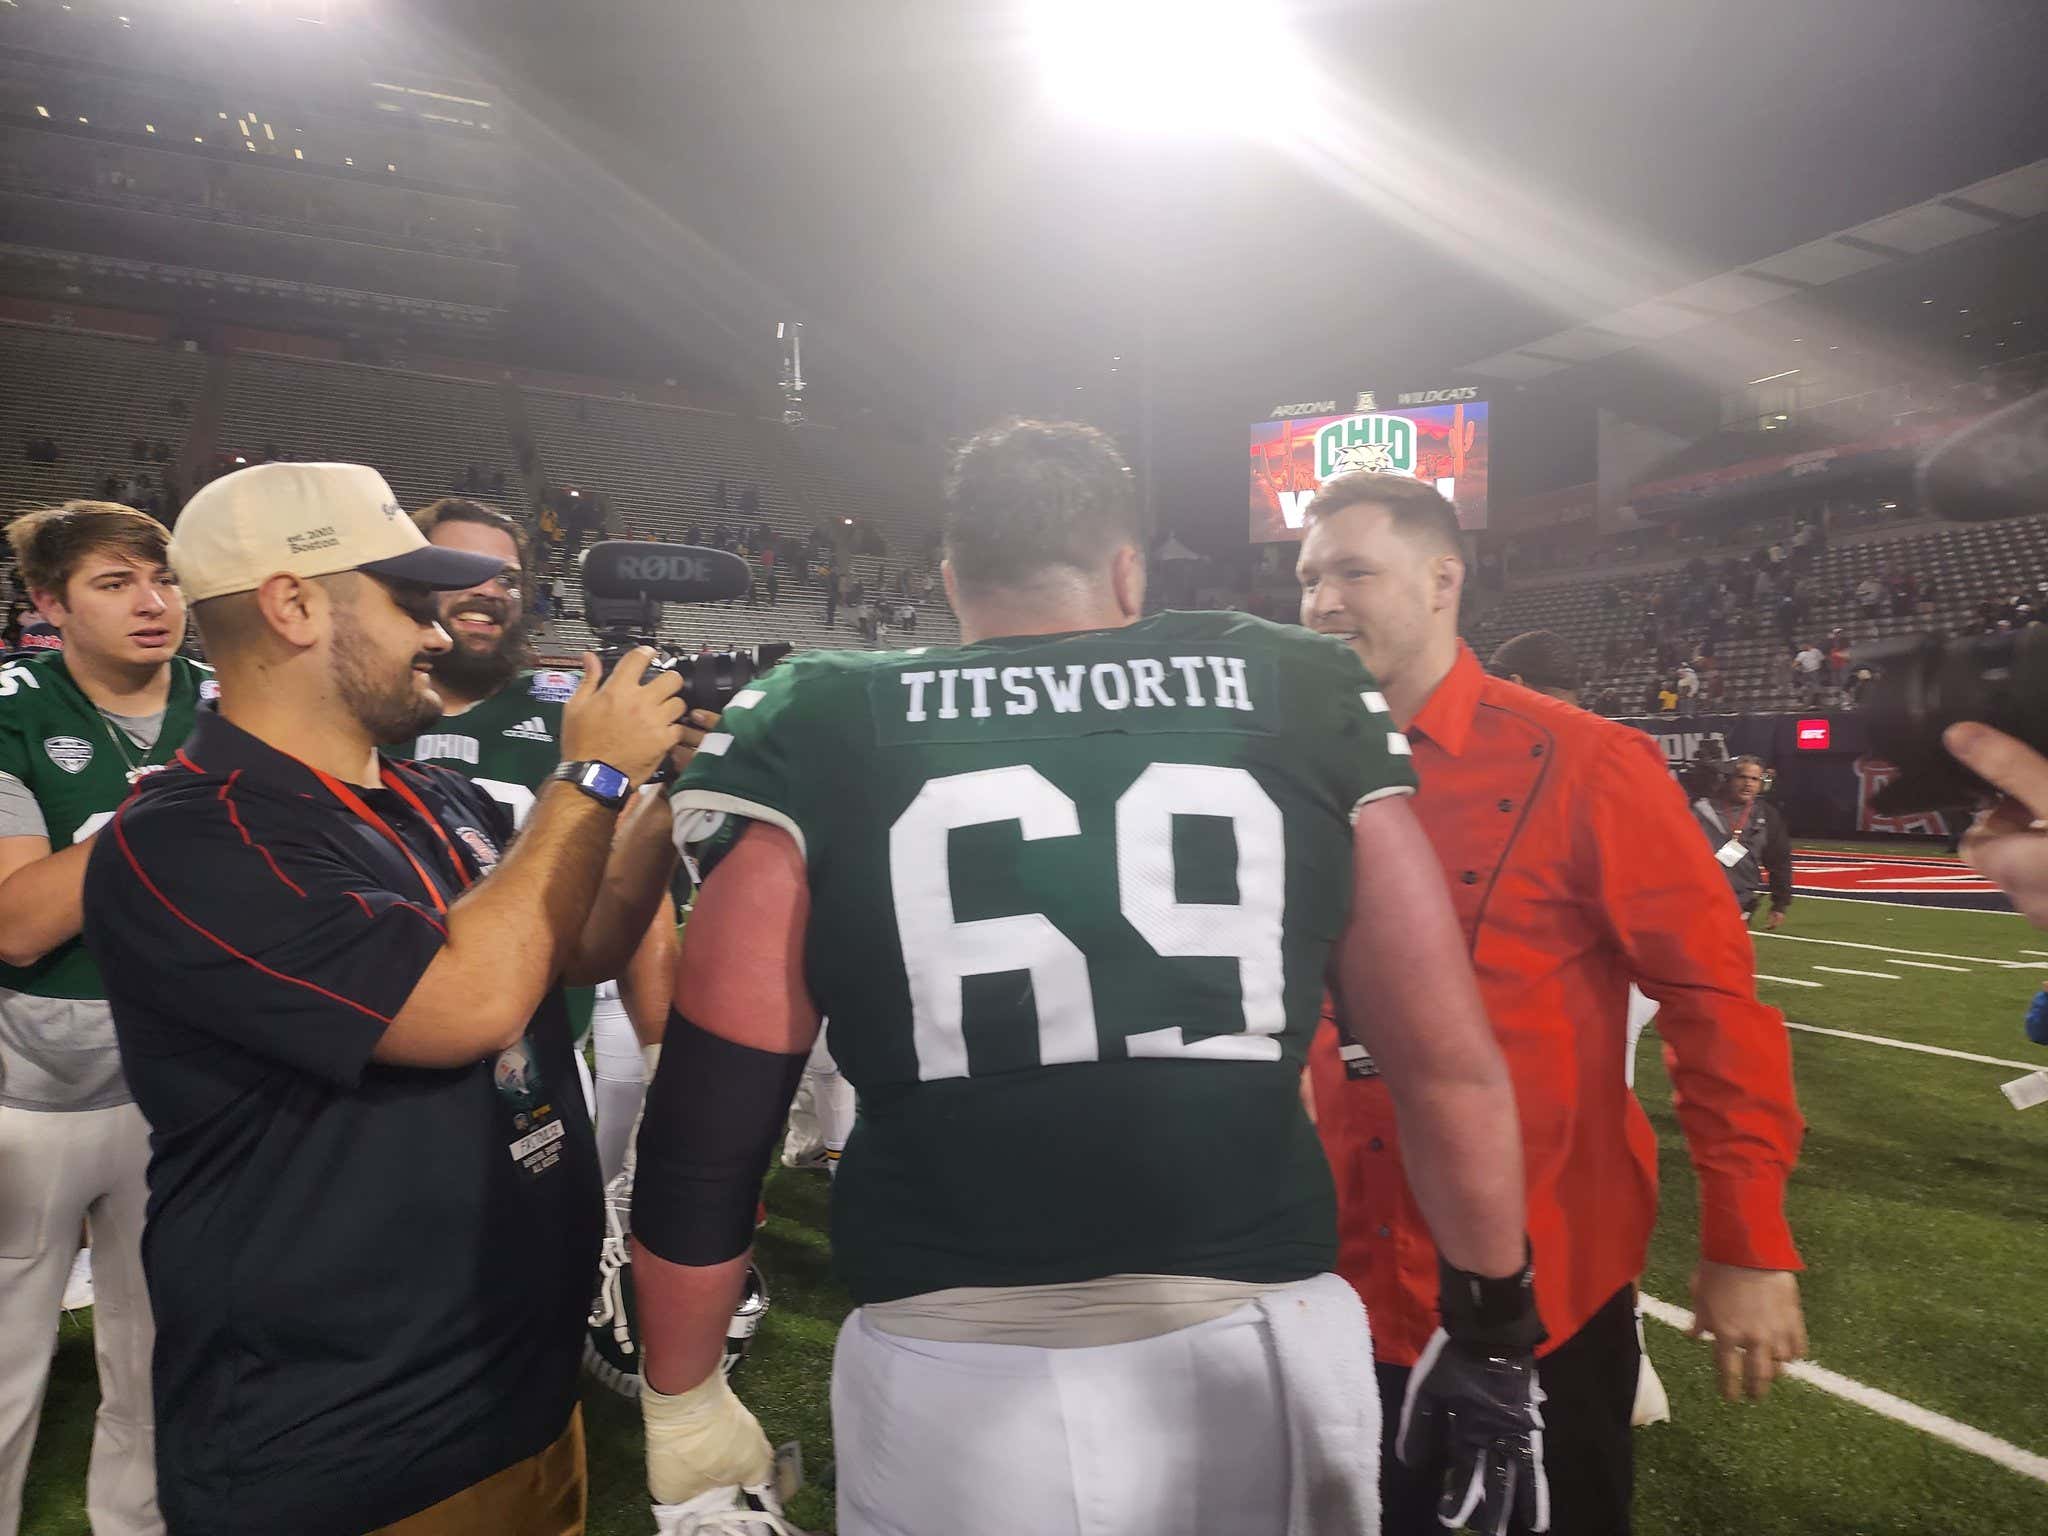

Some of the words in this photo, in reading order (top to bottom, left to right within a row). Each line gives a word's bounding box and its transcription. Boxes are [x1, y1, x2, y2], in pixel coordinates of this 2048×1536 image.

[1270, 401, 1336, 418] ARIZONA
[1398, 387, 1479, 405] WILDCATS
[1319, 417, 1411, 477] OHIO
[901, 656, 1255, 722] TITSWORTH
[414, 734, 479, 764] OHIO
[889, 762, 1287, 1082] 69
